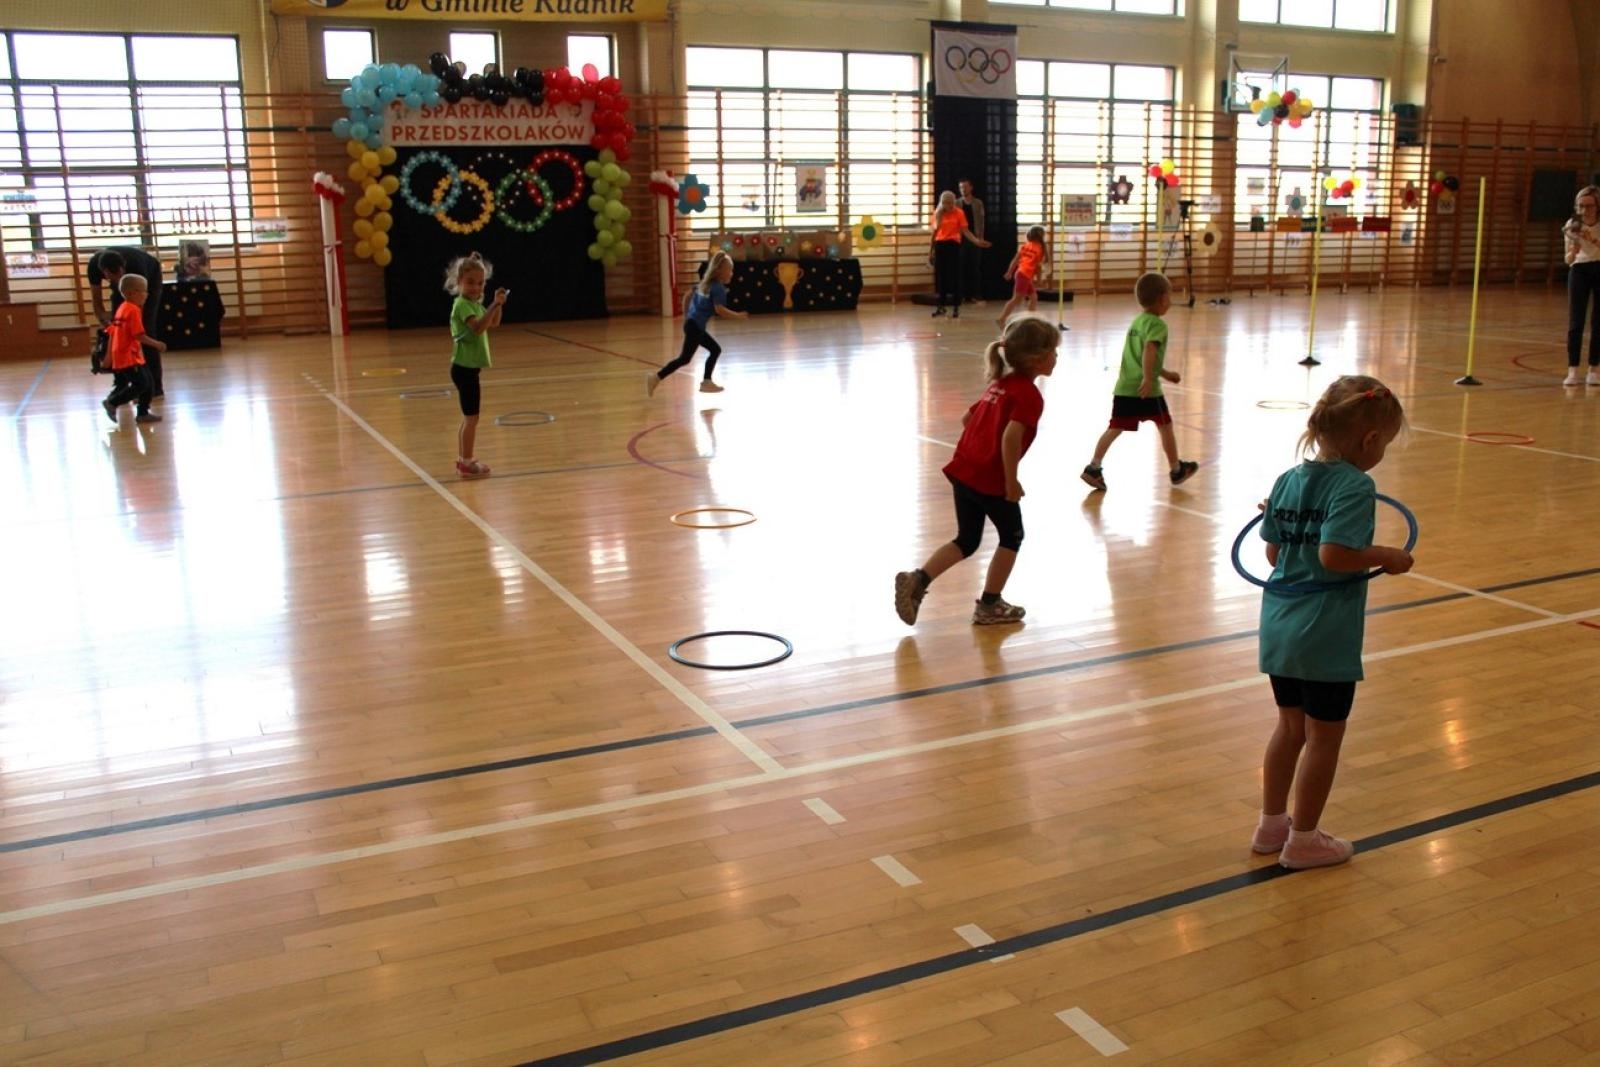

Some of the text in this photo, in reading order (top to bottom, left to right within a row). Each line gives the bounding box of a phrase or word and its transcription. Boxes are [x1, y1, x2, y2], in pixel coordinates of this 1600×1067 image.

[420, 0, 525, 13] Gminie
[420, 103, 559, 119] SPARTAKIADA
[391, 120, 585, 142] PRZEDSZKOLAKÓW
